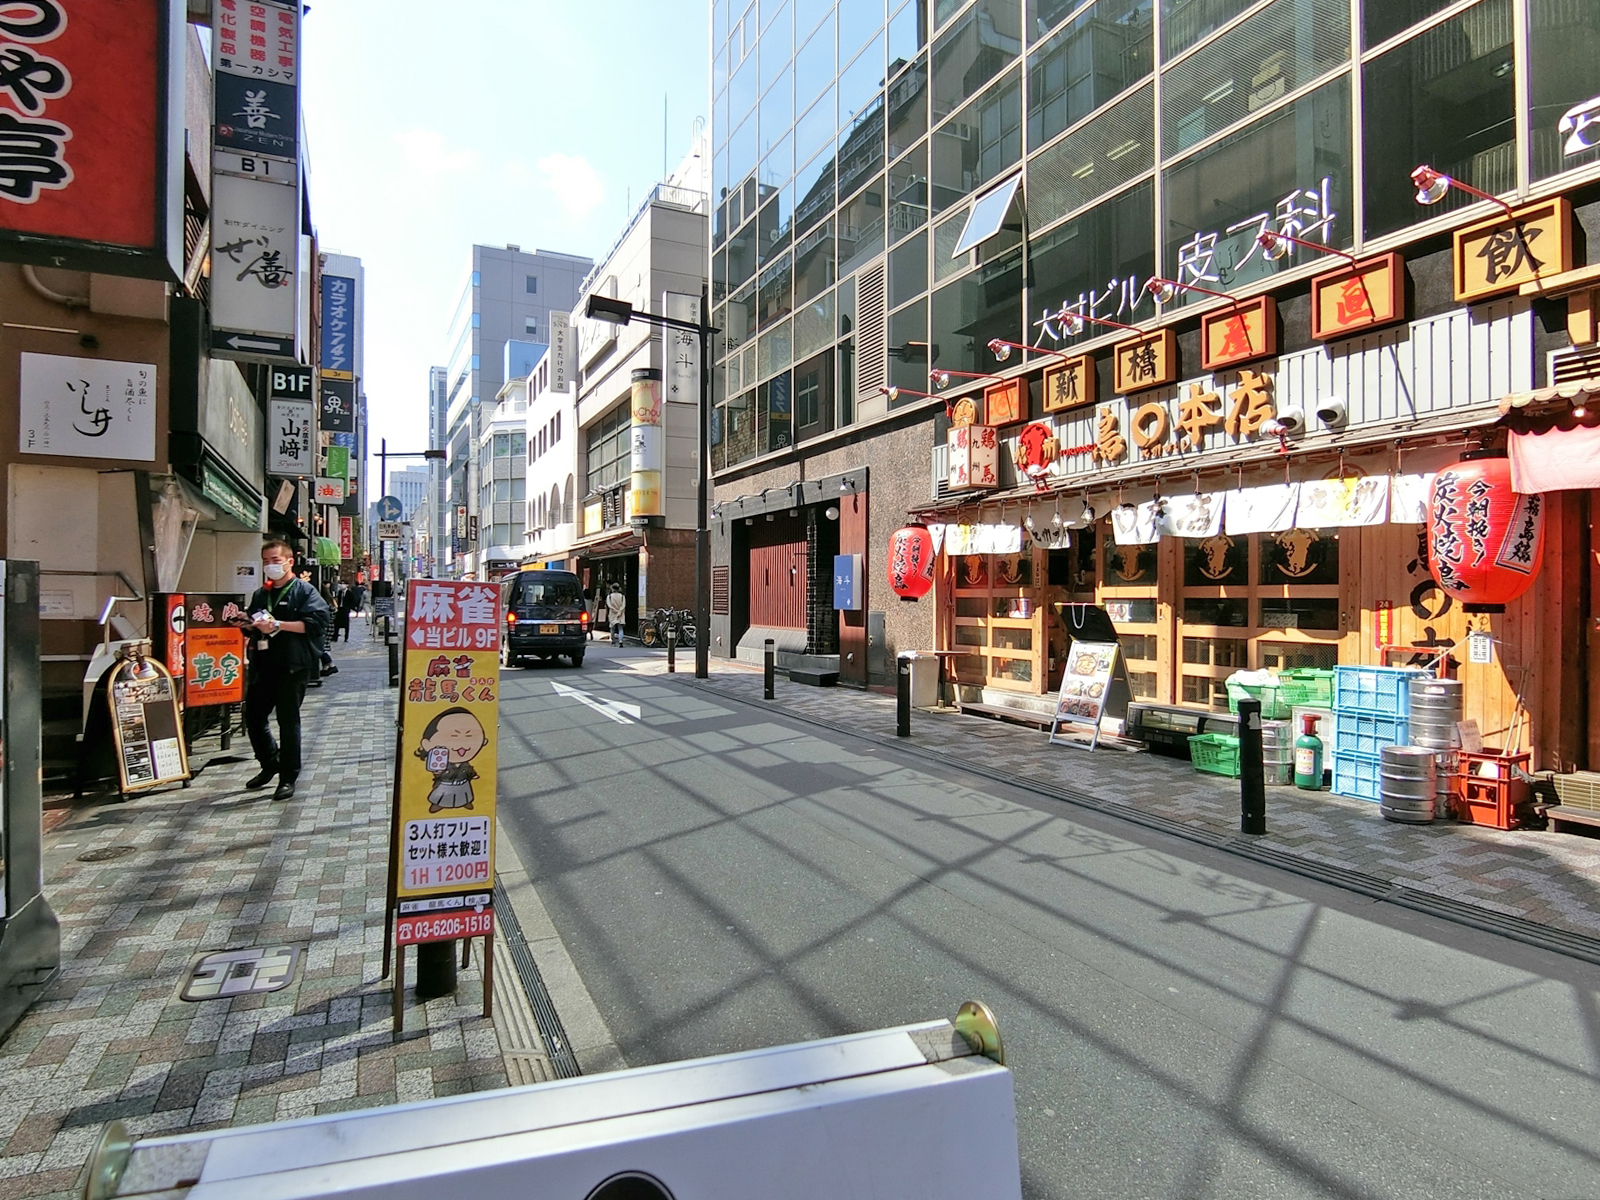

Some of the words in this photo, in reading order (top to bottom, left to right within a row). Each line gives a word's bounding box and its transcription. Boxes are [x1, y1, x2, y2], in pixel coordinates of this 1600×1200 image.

[278, 12, 293, 67] 電気工事
[220, 58, 293, 80] 第一カシマ
[232, 90, 281, 129] 善
[241, 157, 269, 175] B1
[330, 280, 348, 369] カラオケ747
[273, 372, 311, 392] B1F
[411, 583, 498, 625] 麻雀
[426, 626, 472, 649] 当ビル
[474, 628, 498, 649] 9F
[436, 860, 489, 883] 1200円
[415, 914, 491, 939] 03-6206-1518
